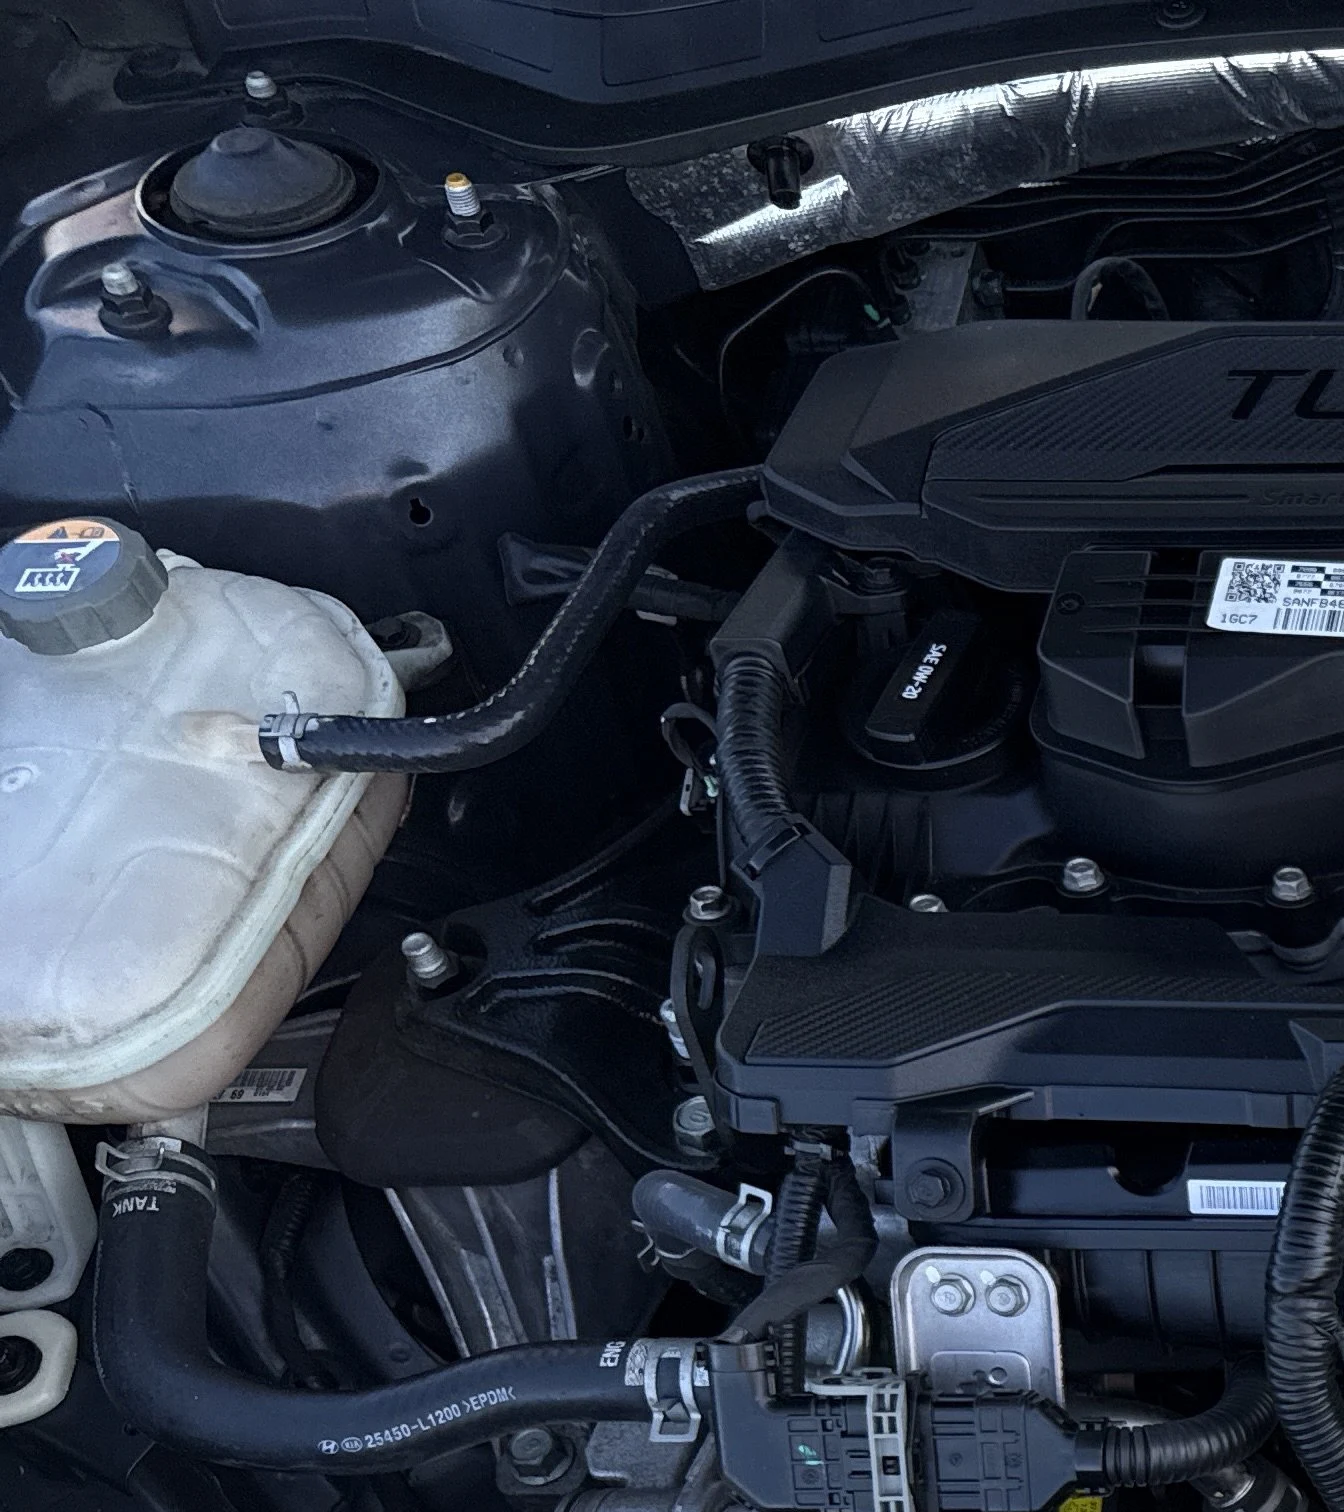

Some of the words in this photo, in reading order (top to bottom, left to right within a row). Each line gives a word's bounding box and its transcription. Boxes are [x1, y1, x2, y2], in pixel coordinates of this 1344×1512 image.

[1220, 614, 1258, 625] 1GC7
[922, 642, 948, 665] SAE
[901, 665, 935, 700] 0W-20
[111, 1195, 160, 1218] TANK
[599, 1340, 626, 1368] ENG
[364, 1404, 462, 1449] 25450-L1200
